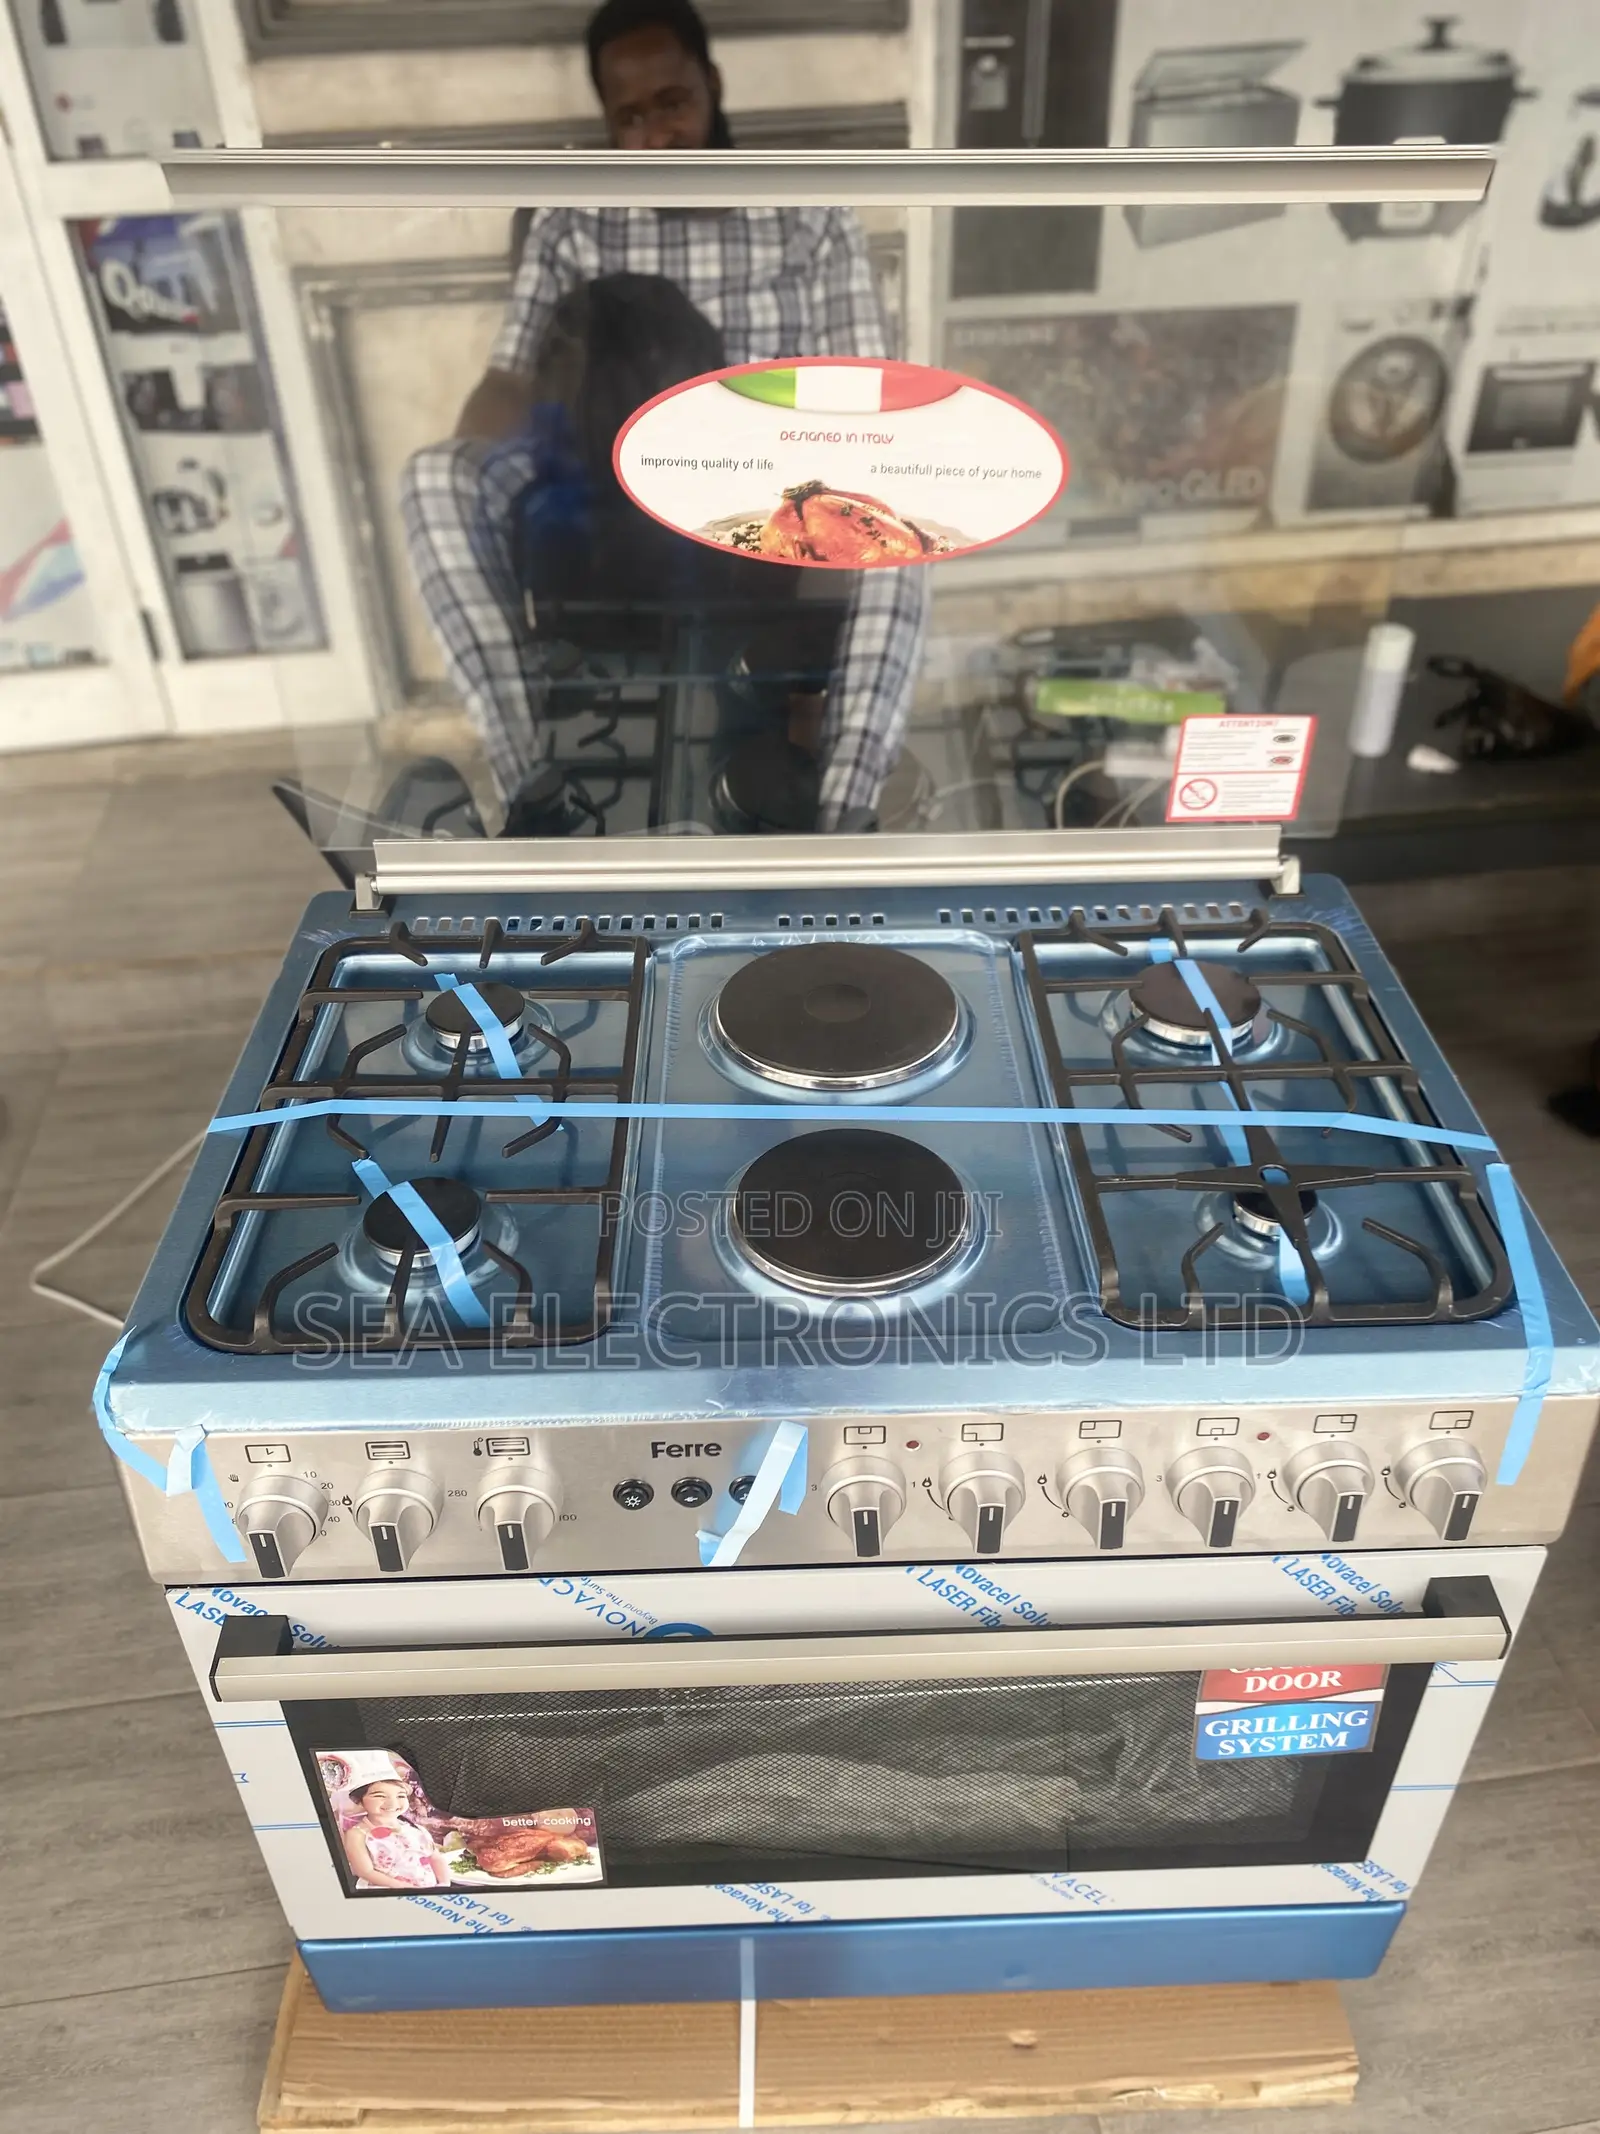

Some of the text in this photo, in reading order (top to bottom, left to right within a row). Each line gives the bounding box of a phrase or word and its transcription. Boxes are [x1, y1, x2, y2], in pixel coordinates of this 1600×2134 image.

[779, 430, 842, 443] DESIGNED
[861, 433, 895, 445] ITALY
[640, 454, 774, 472] improving quality of life
[870, 463, 1042, 480] a beautifull piece of your home
[651, 1441, 722, 1459] Ferre
[304, 1471, 317, 1479] 10
[320, 1482, 334, 1490] 20
[447, 1489, 468, 1498] 280
[810, 1483, 818, 1492] 3
[1281, 1558, 1337, 1600] LASER
[916, 1568, 978, 1612] LASER
[606, 1591, 625, 1609] The
[624, 1602, 659, 1626] Beyond
[1243, 1670, 1343, 1693] DOOR
[1204, 1709, 1370, 1737] GRILLING
[1217, 1731, 1351, 1756] SYSTEM
[502, 1815, 592, 1828] better cooking
[792, 1899, 817, 1915] for
[489, 1909, 516, 1925] for
